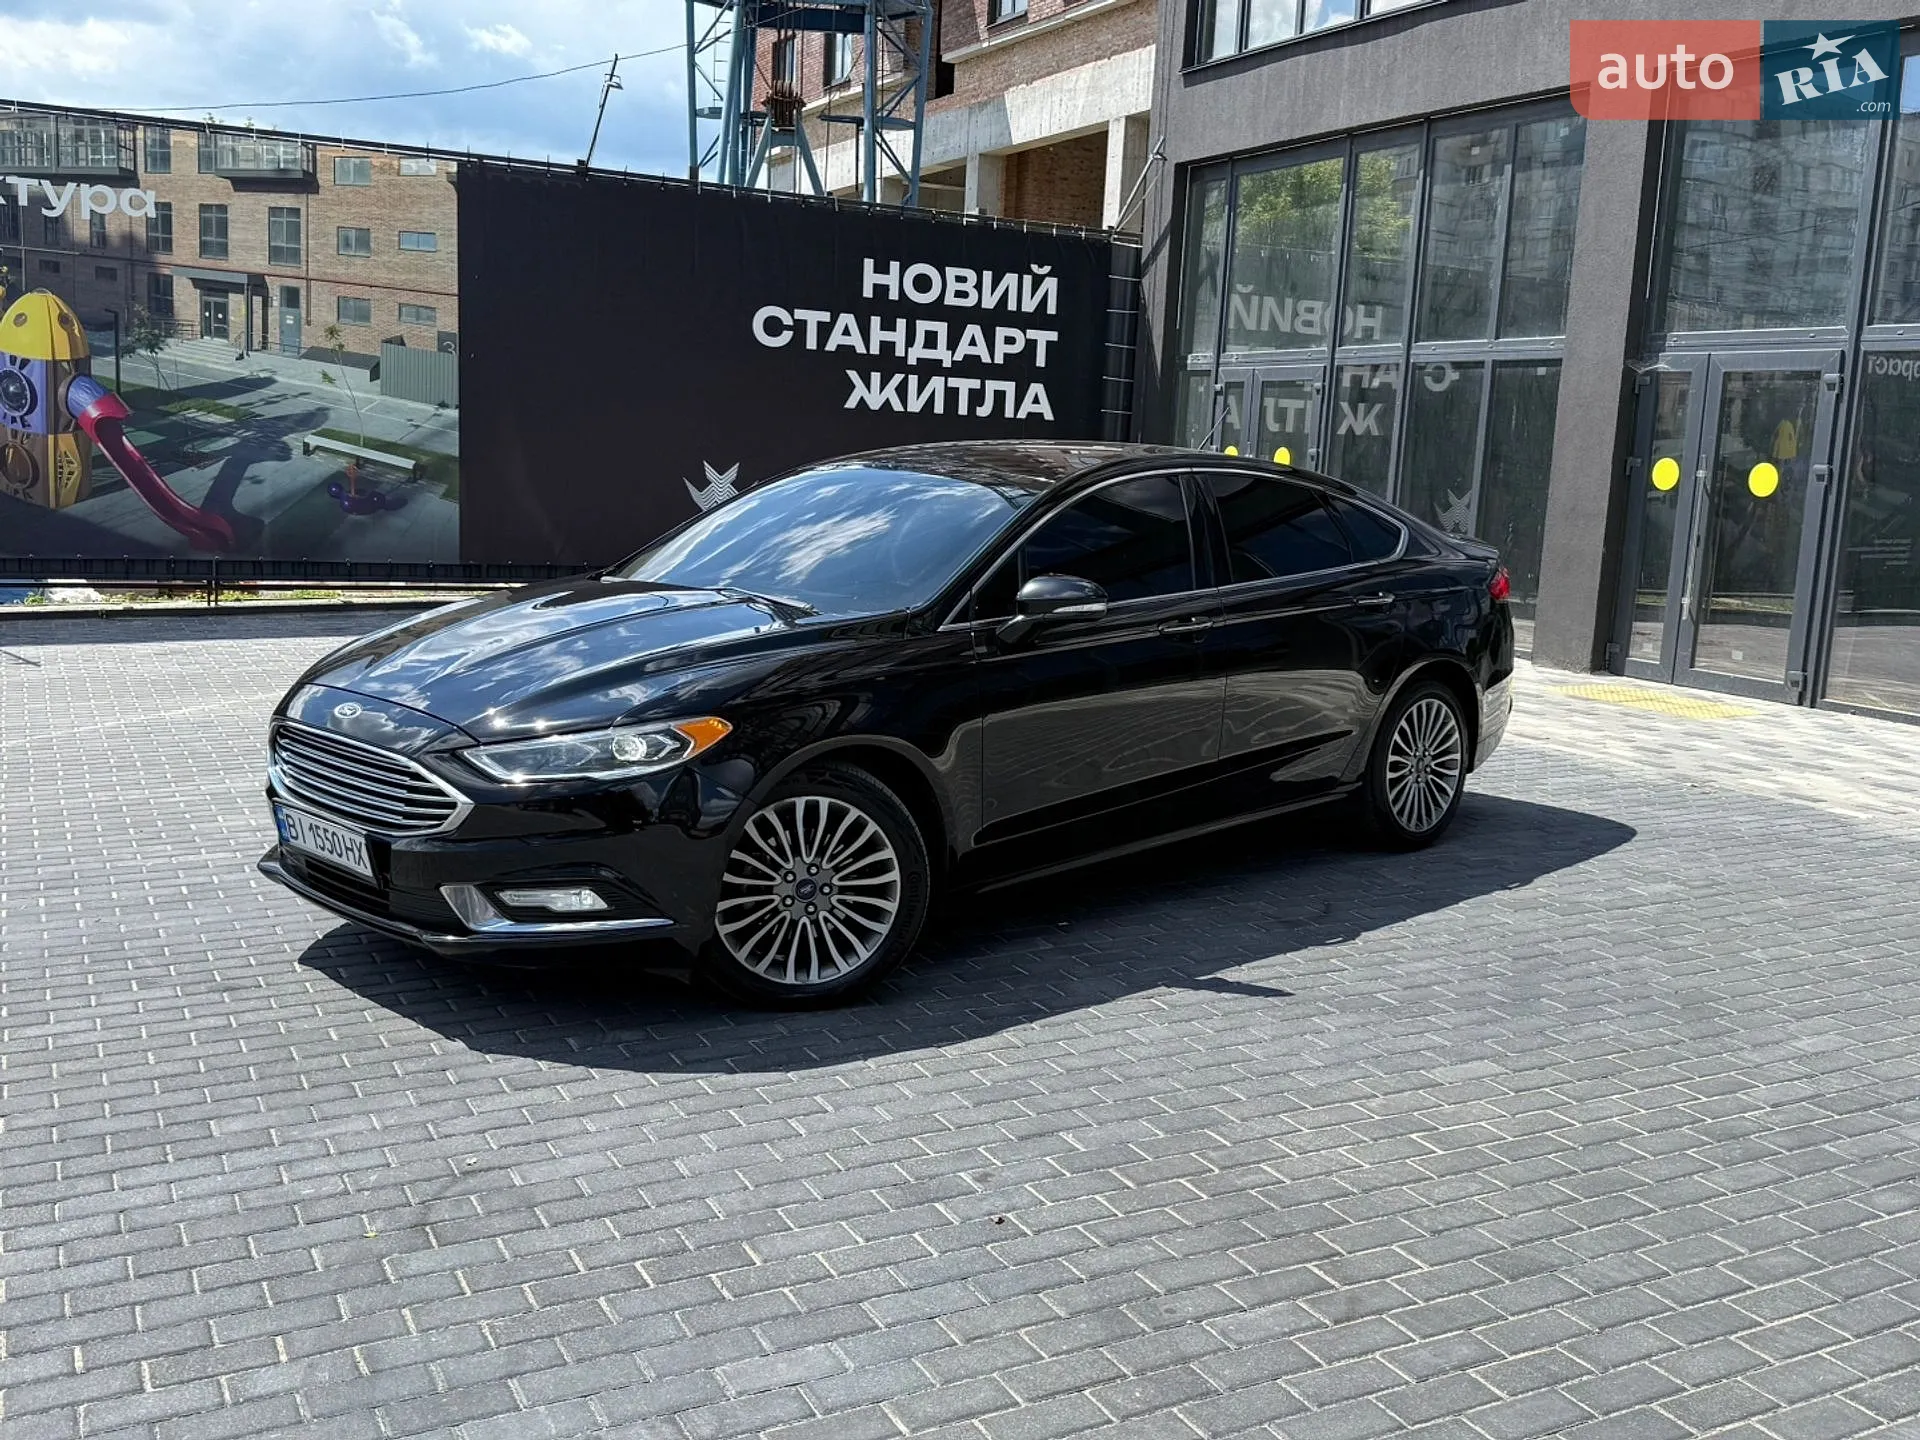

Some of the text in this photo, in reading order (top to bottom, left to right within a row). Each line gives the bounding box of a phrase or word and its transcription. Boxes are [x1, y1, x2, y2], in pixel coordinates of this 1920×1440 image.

[862, 258, 1058, 315] НОВИЙ
[752, 305, 1059, 368] СТАНДАРТ
[844, 369, 1055, 421] ЖИТЛА
